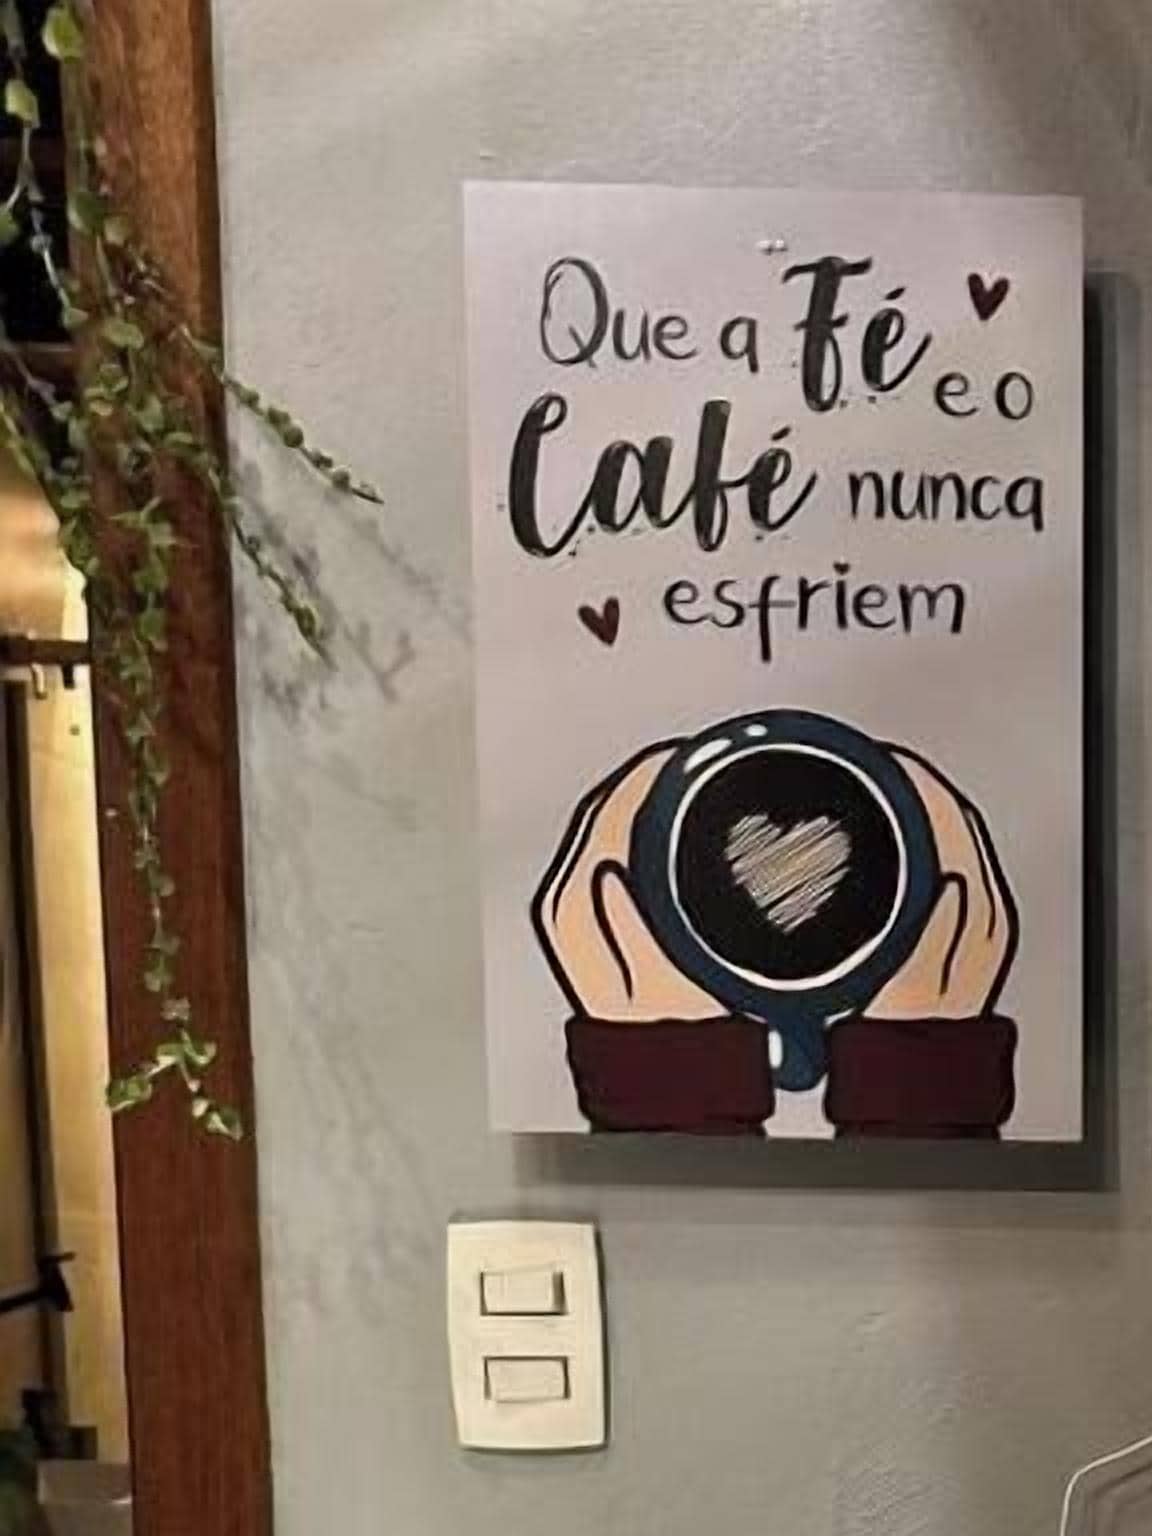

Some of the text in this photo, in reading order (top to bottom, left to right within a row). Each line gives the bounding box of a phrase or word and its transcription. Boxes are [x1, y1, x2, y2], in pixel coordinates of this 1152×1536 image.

[540, 256, 1034, 421] Que a Fé e o
[508, 392, 1045, 558] Café nunca
[662, 562, 966, 664] esfriem
